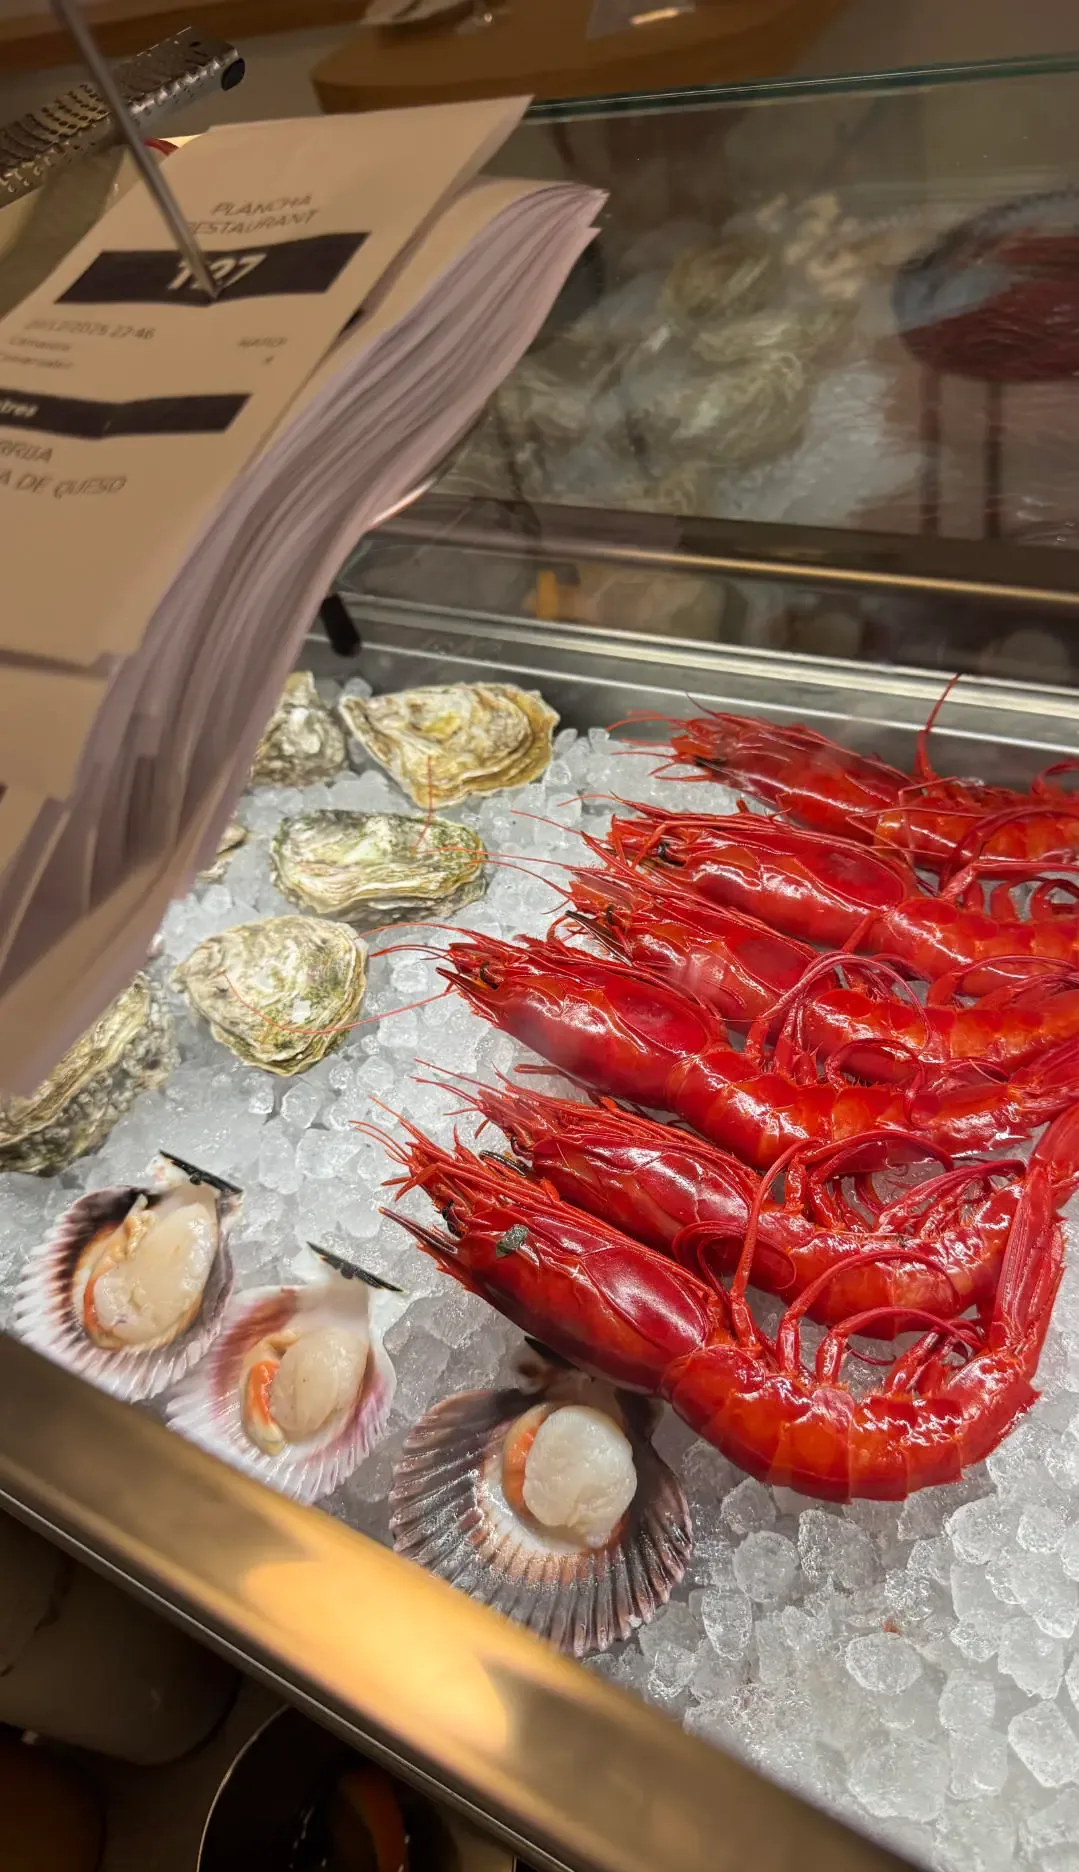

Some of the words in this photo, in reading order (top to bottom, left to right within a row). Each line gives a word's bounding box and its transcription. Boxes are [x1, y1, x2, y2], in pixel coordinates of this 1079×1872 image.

[210, 194, 312, 216] PLANCHA
[15, 472, 53, 494] DE
[53, 475, 128, 499] QUESO
